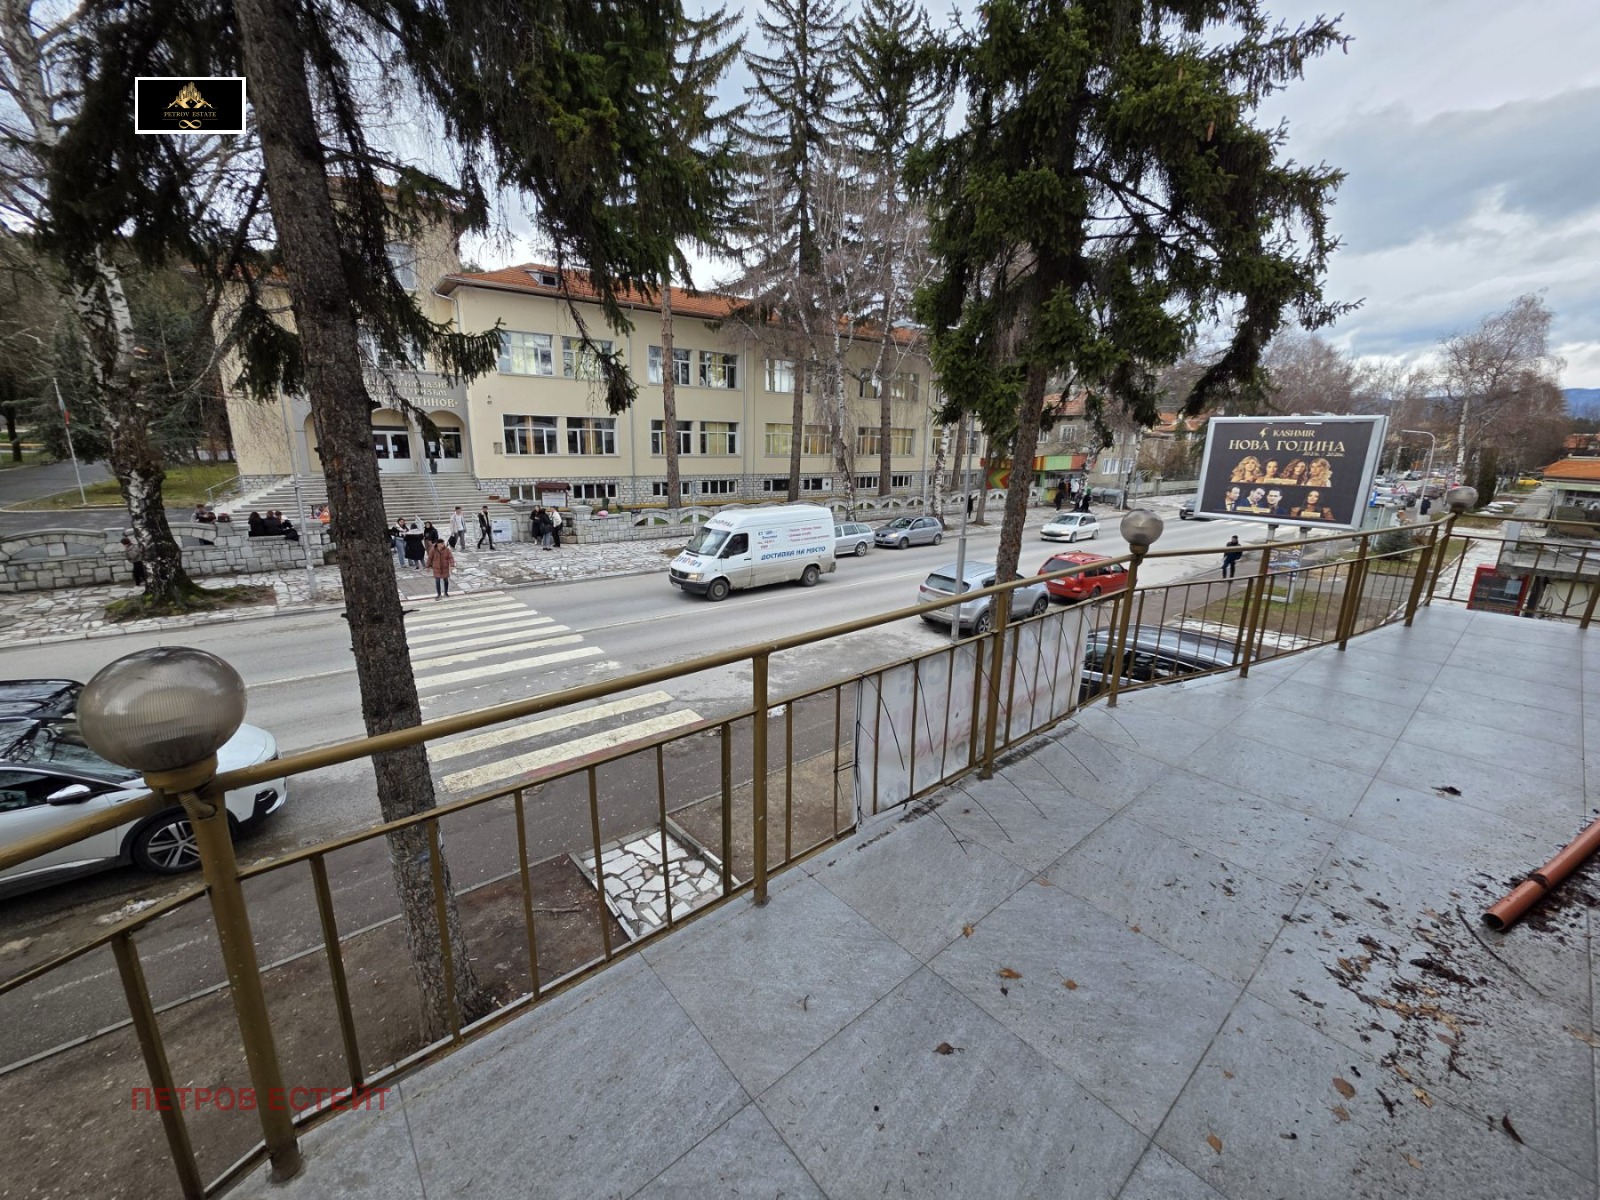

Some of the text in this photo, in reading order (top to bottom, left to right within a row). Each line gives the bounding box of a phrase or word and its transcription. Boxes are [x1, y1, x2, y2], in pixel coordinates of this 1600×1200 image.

[1273, 429, 1315, 437] KASHMIR
[1228, 439, 1345, 452] НОВА ГОДИНА
[761, 551, 794, 560] ДОСТАВКА
[806, 545, 826, 555] МЯСТО
